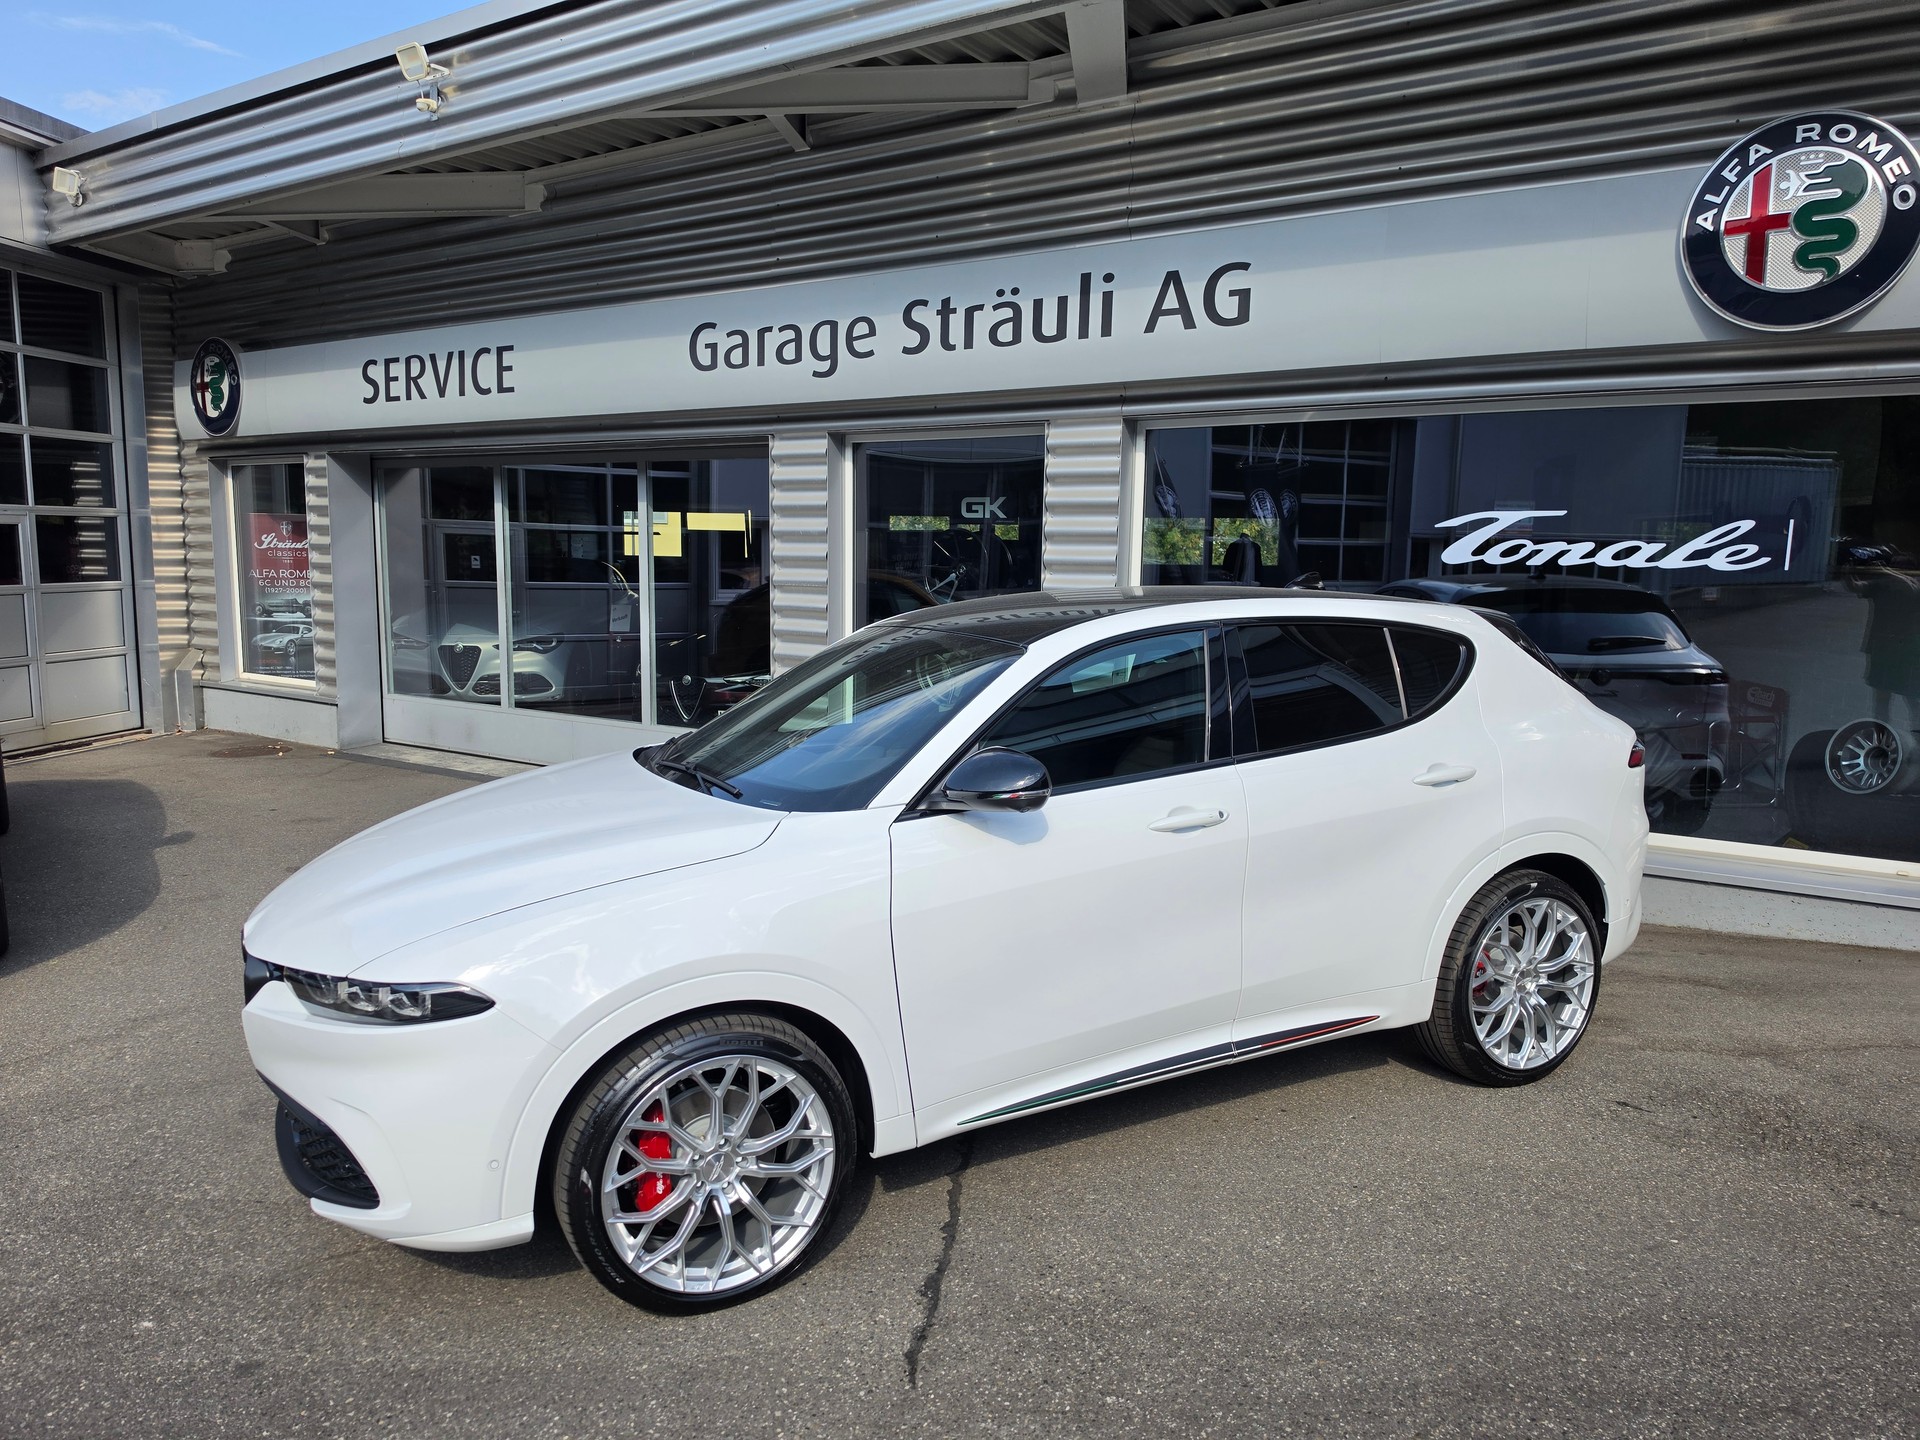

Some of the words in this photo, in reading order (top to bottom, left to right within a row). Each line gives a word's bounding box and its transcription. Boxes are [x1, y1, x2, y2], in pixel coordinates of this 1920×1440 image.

[1695, 143, 1773, 232] ALFA
[1795, 123, 1916, 211] ROMEO
[689, 316, 877, 379] Garage
[901, 271, 1115, 355] Sträuli
[1143, 261, 1252, 334] AG
[361, 344, 515, 405] SERVICE
[961, 496, 1008, 519] GK
[254, 532, 309, 549] Sträul
[1434, 510, 1771, 571] Tonale
[267, 549, 307, 557] classics
[249, 569, 277, 578] ALFA
[280, 569, 311, 578] ROME
[259, 579, 271, 587] 6C
[274, 579, 296, 587] UND
